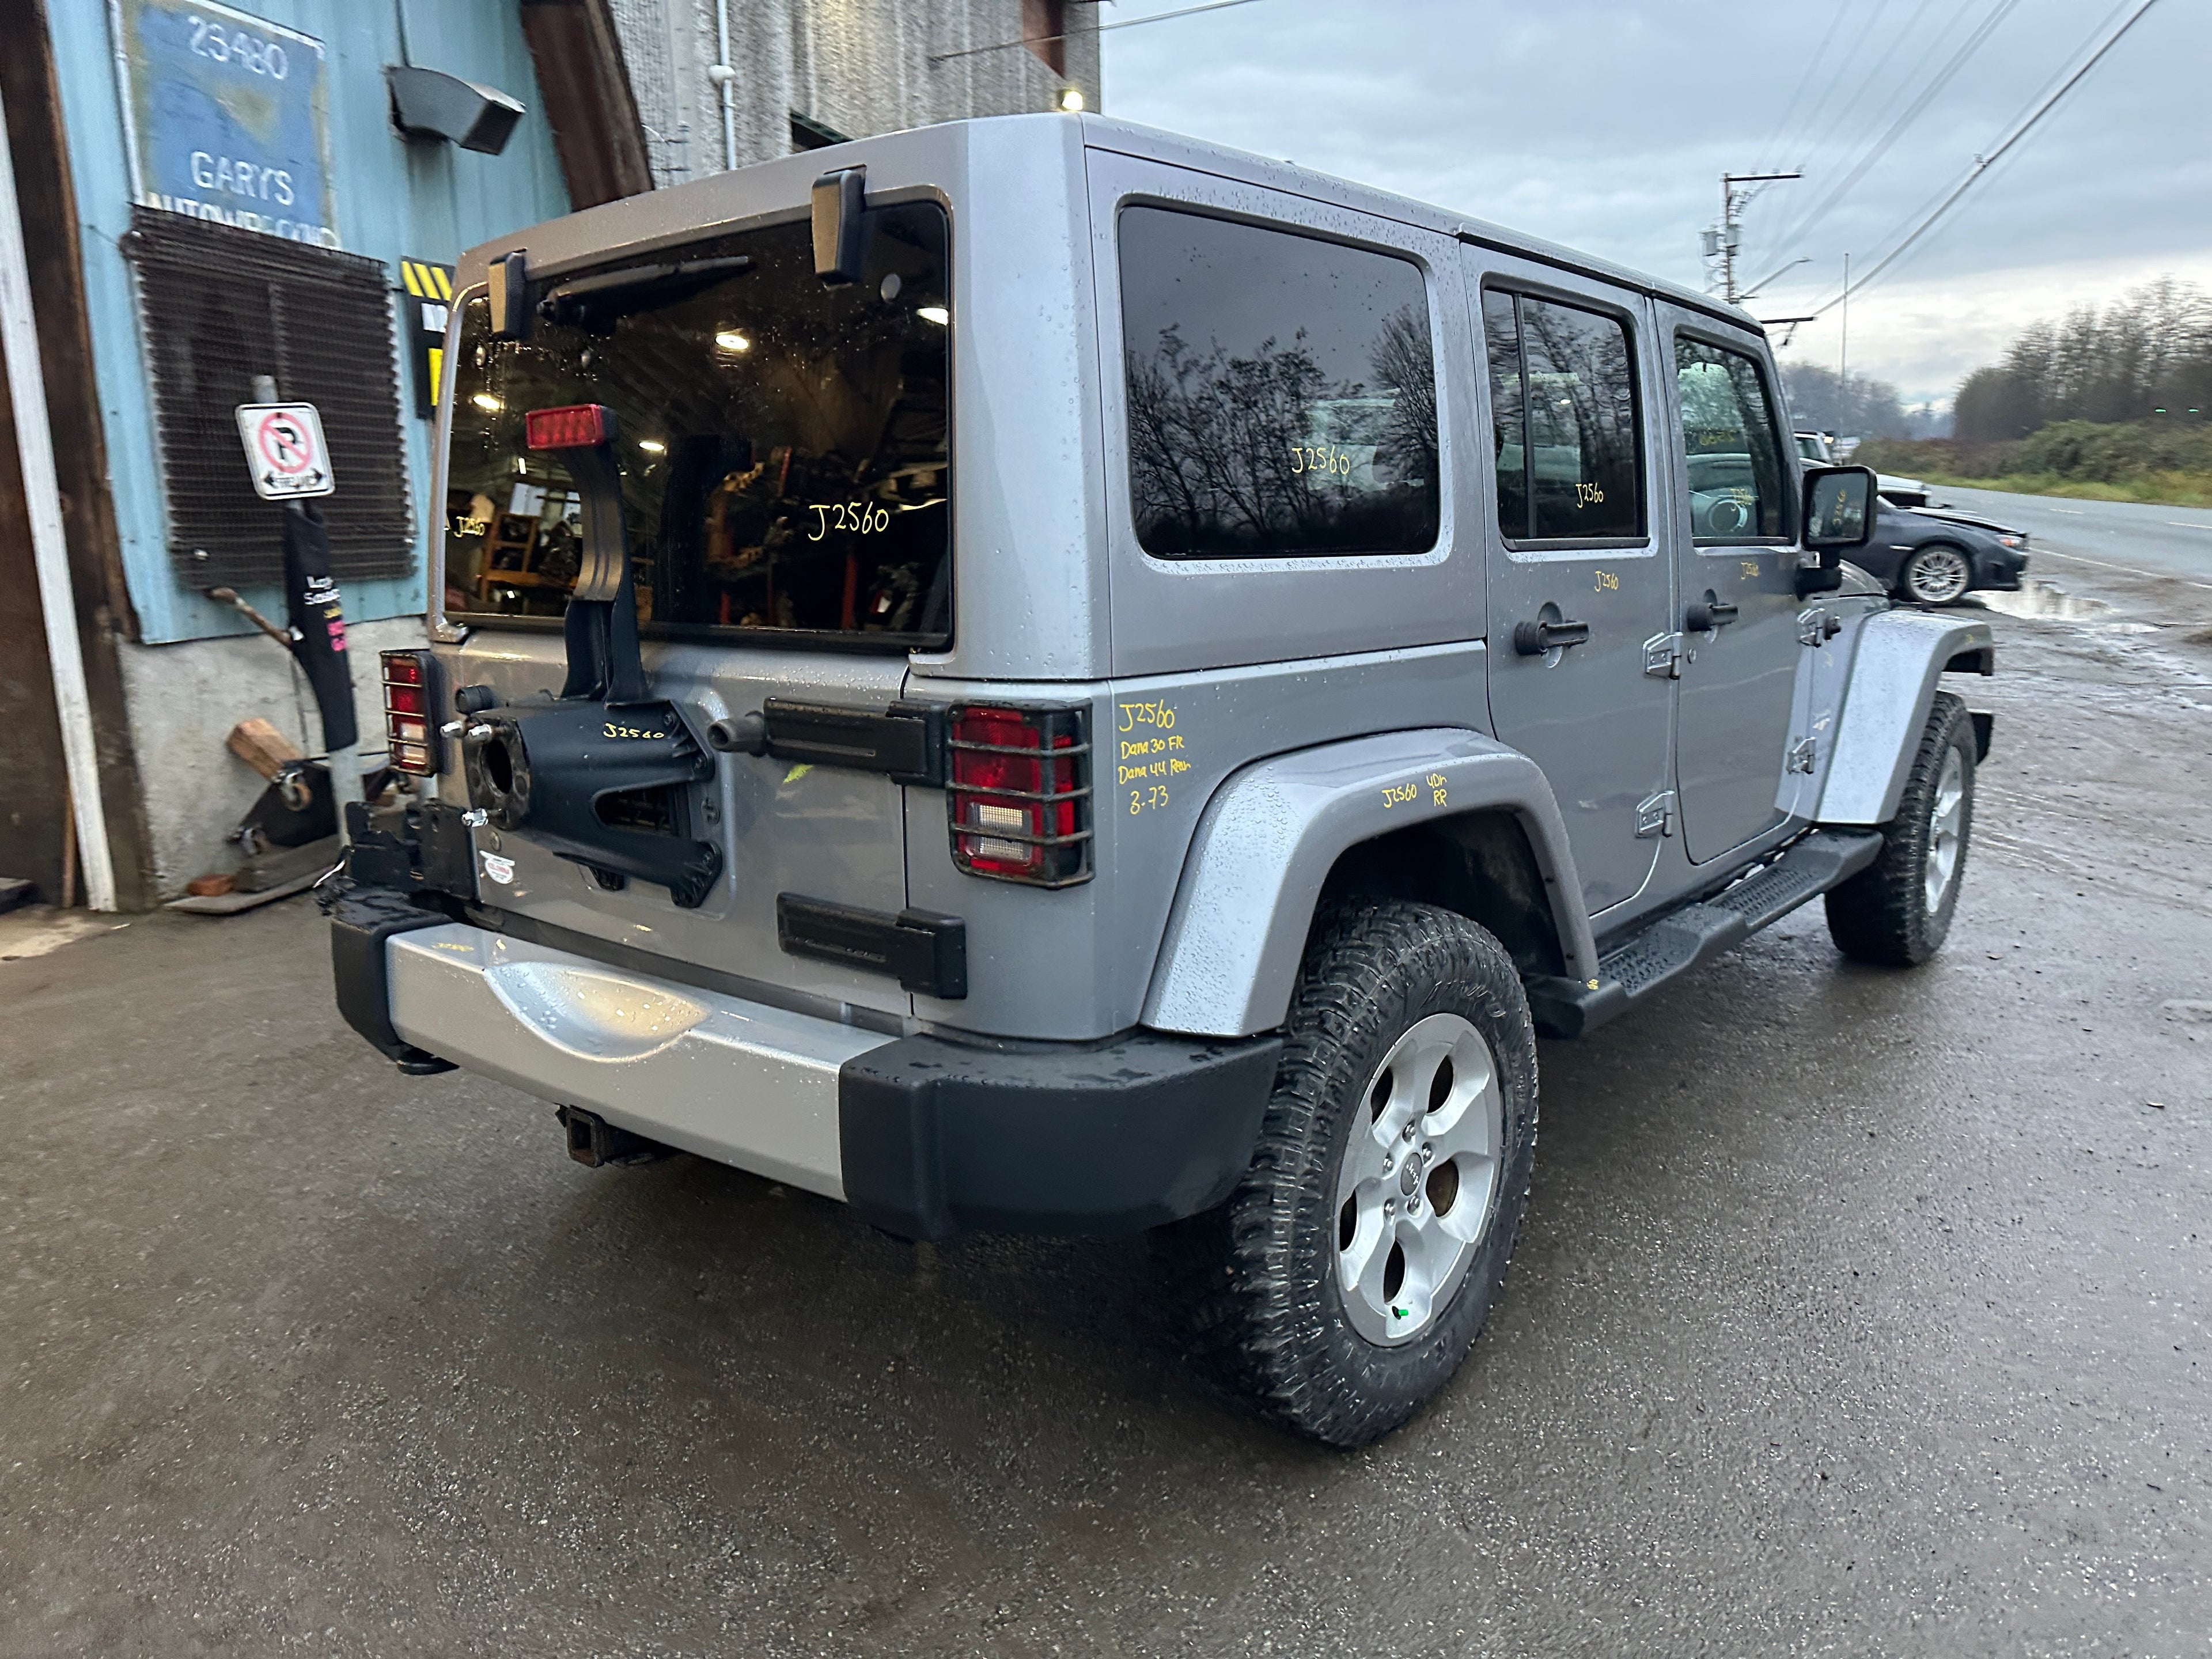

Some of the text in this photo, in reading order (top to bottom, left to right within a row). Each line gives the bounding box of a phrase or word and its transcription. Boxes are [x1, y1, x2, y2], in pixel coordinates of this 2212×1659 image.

[1292, 445, 1350, 475] J2560
[1575, 482, 1604, 508] J2560
[808, 501, 889, 541] J2560
[1594, 570, 1619, 592] J2560
[1119, 699, 1175, 732] J2560
[603, 723, 665, 738] J2560
[1120, 735, 1184, 759] Dana 30 FR
[1118, 765, 1147, 784] Dana
[1150, 760, 1167, 777] 44
[1382, 783, 1417, 808] J2560
[1433, 789, 1448, 807] RR
